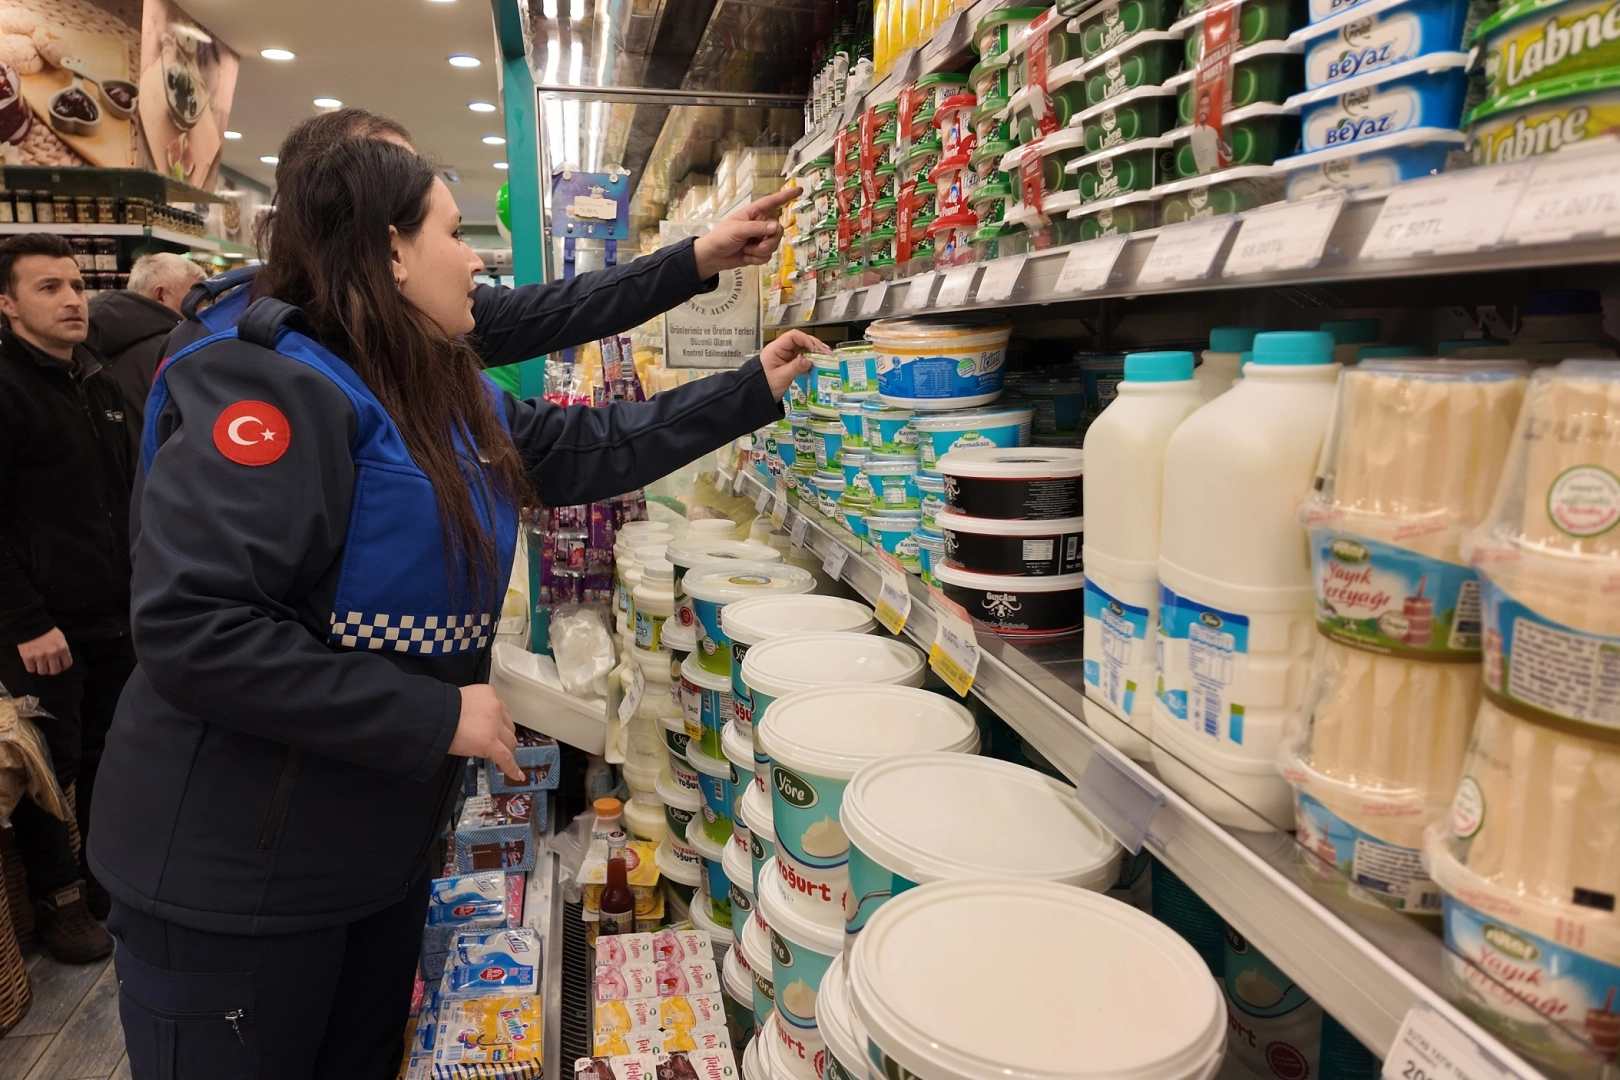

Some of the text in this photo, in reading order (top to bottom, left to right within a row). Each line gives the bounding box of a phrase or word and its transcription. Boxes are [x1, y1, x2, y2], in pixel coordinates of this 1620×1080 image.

[1100, 21, 1125, 50] Labne
[1327, 44, 1391, 79] Beyaz
[1103, 74, 1126, 100] Labne
[1099, 127, 1123, 150] Labne
[1326, 115, 1390, 145] Beyaz
[1094, 175, 1118, 198] Labne
[669, 323, 703, 335] Ürünlerimiz
[712, 324, 733, 336] Üretim
[733, 326, 755, 336] Yerleri
[690, 337, 733, 346] Düzenli Olarak
[682, 348, 704, 357] Kontrol
[954, 441, 990, 449] Kaymaksız
[1329, 561, 1373, 589] Yayık
[1322, 578, 1392, 612] Tereyağı
[777, 773, 806, 803] Yöre
[673, 808, 689, 821] Yöre
[673, 850, 700, 864] Yoğurt
[776, 855, 832, 902] Yoğurt
[731, 883, 746, 907] Yöre
[1480, 945, 1544, 986] Yayık
[754, 972, 774, 996] Yöre
